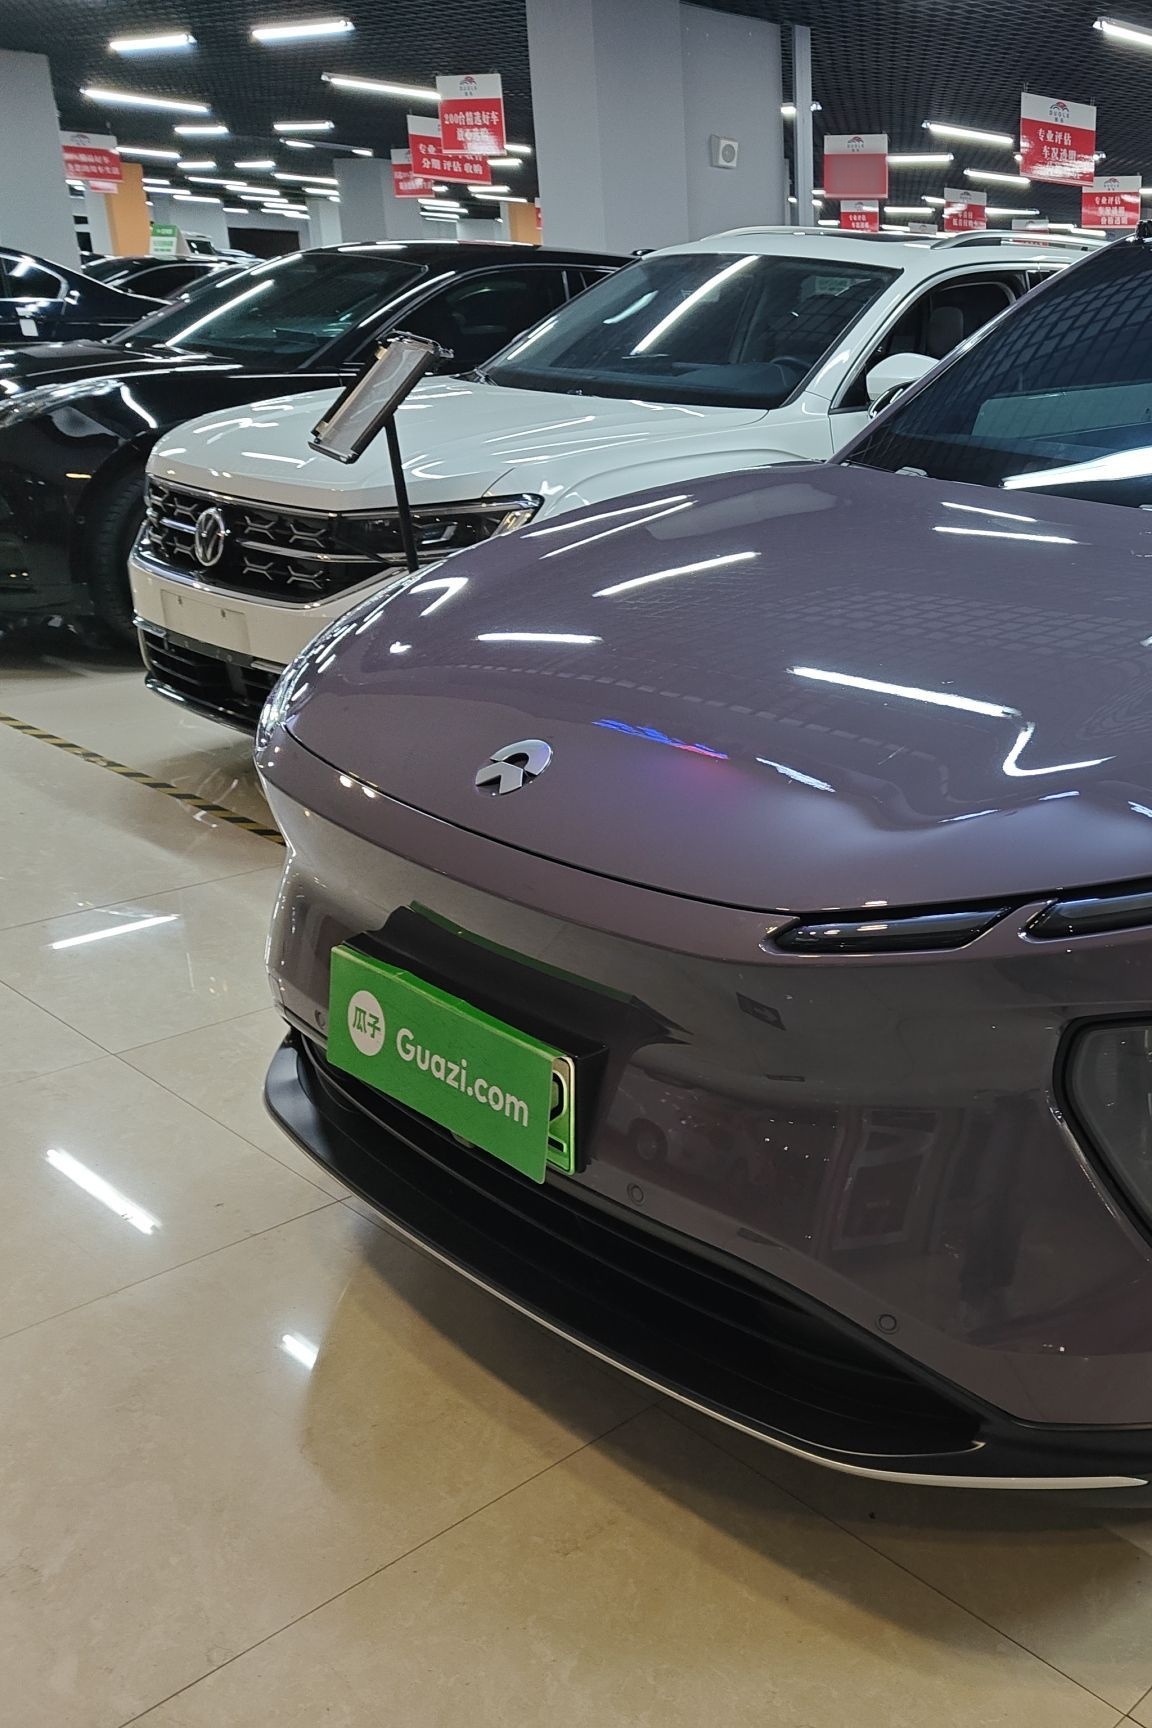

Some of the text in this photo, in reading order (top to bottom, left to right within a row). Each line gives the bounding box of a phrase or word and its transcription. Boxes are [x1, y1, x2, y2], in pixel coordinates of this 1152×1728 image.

[1037, 128, 1072, 146] 专业评估
[352, 1006, 381, 1039] 瓜子
[396, 1027, 529, 1127] Guazi.com
